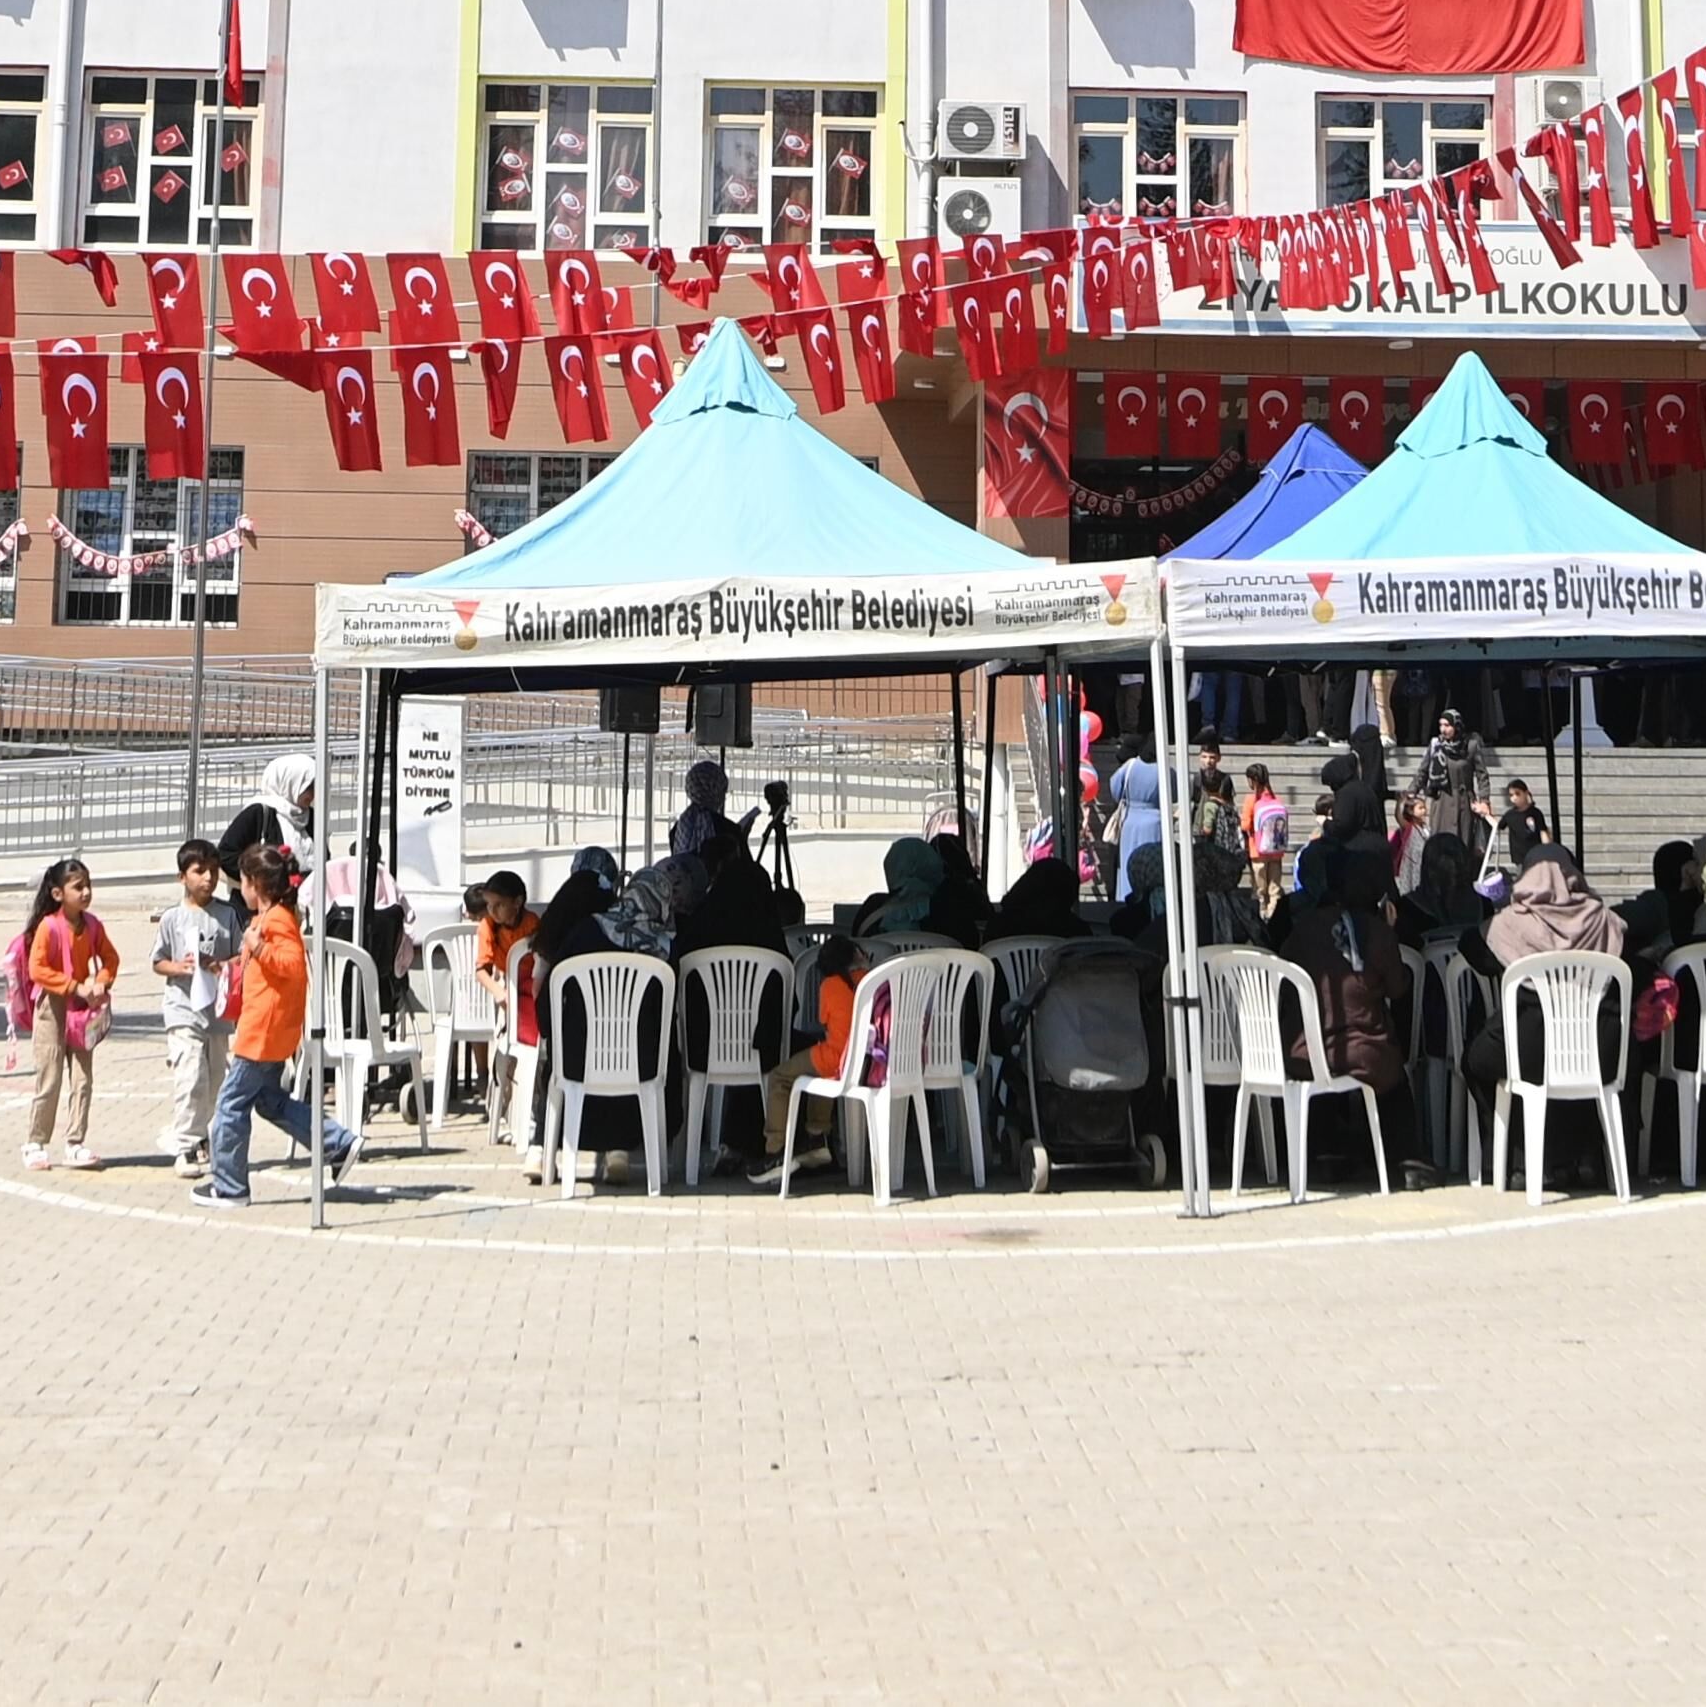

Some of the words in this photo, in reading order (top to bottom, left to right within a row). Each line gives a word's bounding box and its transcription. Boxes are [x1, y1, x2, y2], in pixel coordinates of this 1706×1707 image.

[1004, 108, 1015, 148] VESTEL
[1205, 591, 1307, 604] Kahramanmaraş
[1358, 572, 1548, 616] Kahramanmaraş
[1554, 565, 1683, 618] Büyükşehir
[995, 595, 1100, 611] Kahramanmaraş
[505, 599, 702, 641] Kahramanmaraş
[709, 588, 845, 643] Büyükşehir
[851, 586, 974, 637] Belediyesi
[1052, 610, 1100, 623] Belediyesi
[1261, 605, 1308, 618] Belediyesi
[343, 617, 451, 630] Kahramanmaraş
[400, 634, 451, 646] Belediyesi
[422, 731, 439, 742] NE
[409, 749, 451, 761] MUTLU
[403, 764, 455, 780] TÜRKÜM
[405, 785, 450, 799] DİYENE
